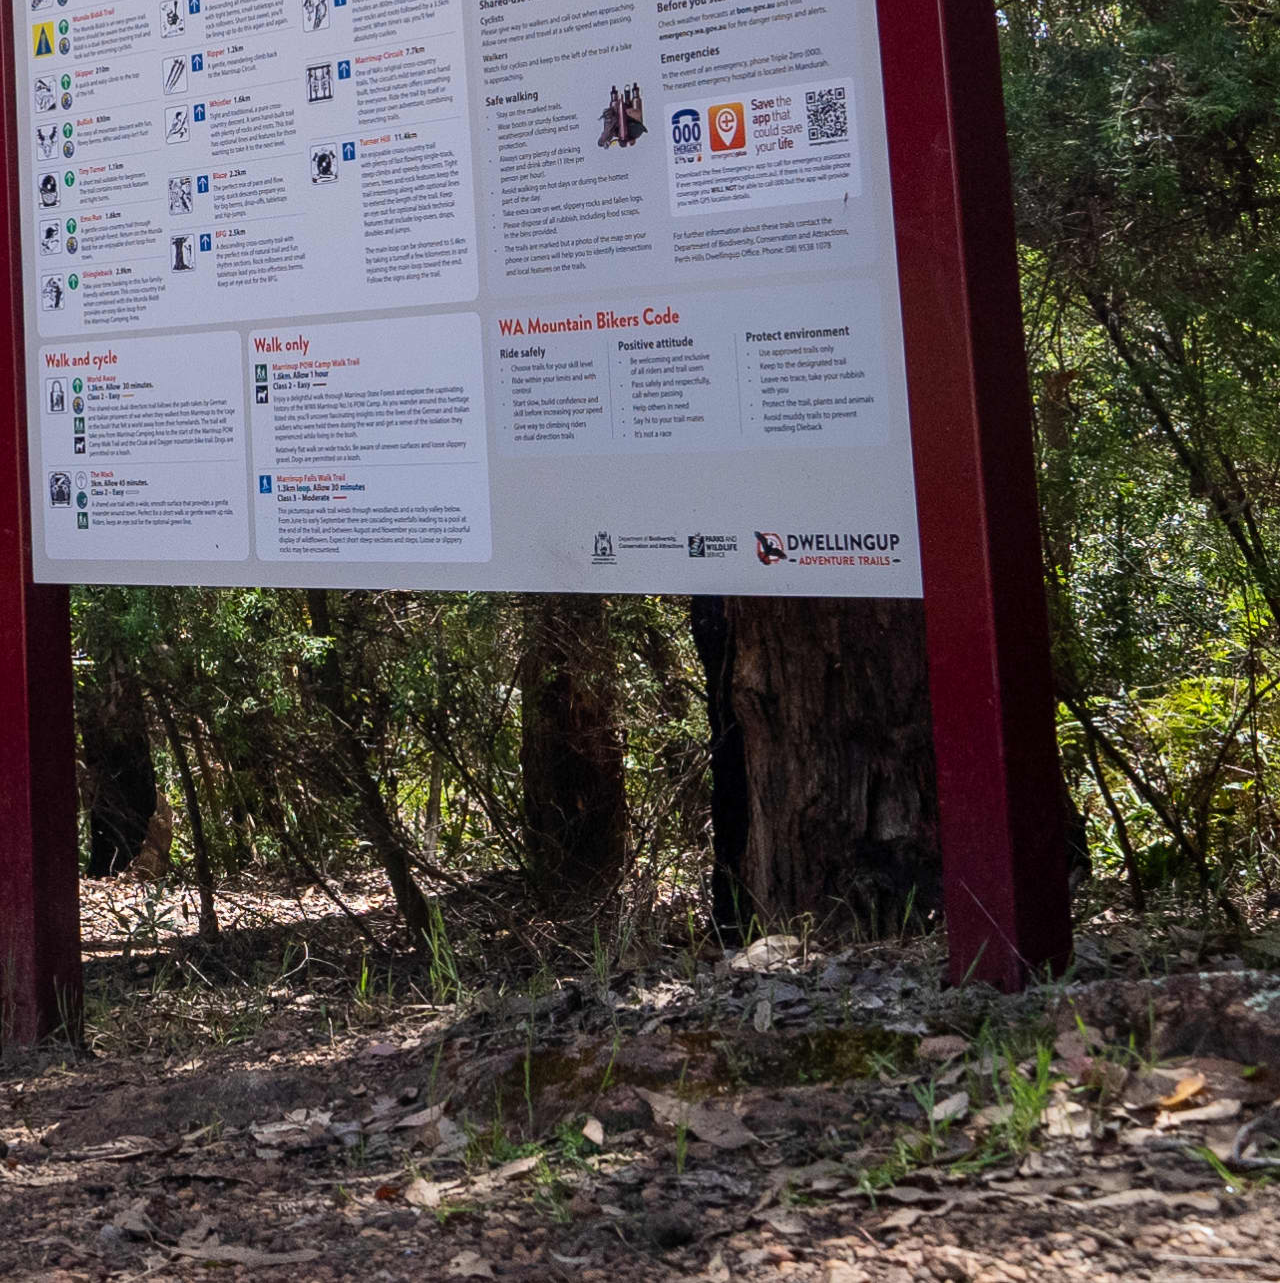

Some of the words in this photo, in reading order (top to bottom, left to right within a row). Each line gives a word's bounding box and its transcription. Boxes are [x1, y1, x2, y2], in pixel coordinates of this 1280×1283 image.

[657, 0, 687, 12] Before
[480, 15, 504, 26] Cyclists
[482, 53, 507, 62] Walkers
[660, 46, 719, 63] Emergencies
[485, 95, 503, 106] Safe
[505, 91, 538, 103] walking
[751, 98, 774, 110] Save
[776, 95, 791, 106] the
[752, 113, 770, 126] app
[772, 110, 790, 121] that
[672, 123, 701, 143] 000
[753, 123, 779, 138] could
[781, 123, 802, 135] save
[673, 144, 702, 154] EMERGENCY
[755, 142, 776, 154] your
[777, 136, 793, 149] life
[498, 318, 524, 335] WA
[528, 314, 591, 334] Mountain
[596, 311, 638, 329] Bikers
[642, 306, 678, 325] Code
[745, 331, 781, 342] Protect
[784, 325, 849, 339] environment
[254, 336, 282, 352] Walk
[285, 334, 309, 354] only
[618, 339, 653, 350] Positive
[656, 336, 693, 348] attitude
[771, 346, 801, 356] approved
[803, 345, 819, 353] trails
[819, 344, 834, 354] only
[45, 353, 69, 367] Walk
[72, 351, 89, 366] and
[92, 349, 117, 369] cycle
[500, 348, 518, 358] Ride
[520, 346, 545, 358] safely
[759, 362, 776, 370] Keep
[796, 358, 832, 368] designated
[833, 357, 846, 365] trail
[705, 535, 724, 543] PARKS
[787, 534, 900, 551] DWELLINGUP
[705, 543, 737, 551] WILDLIFE
[798, 557, 854, 566] ADVENTURE
[858, 556, 890, 565] TRAILS
